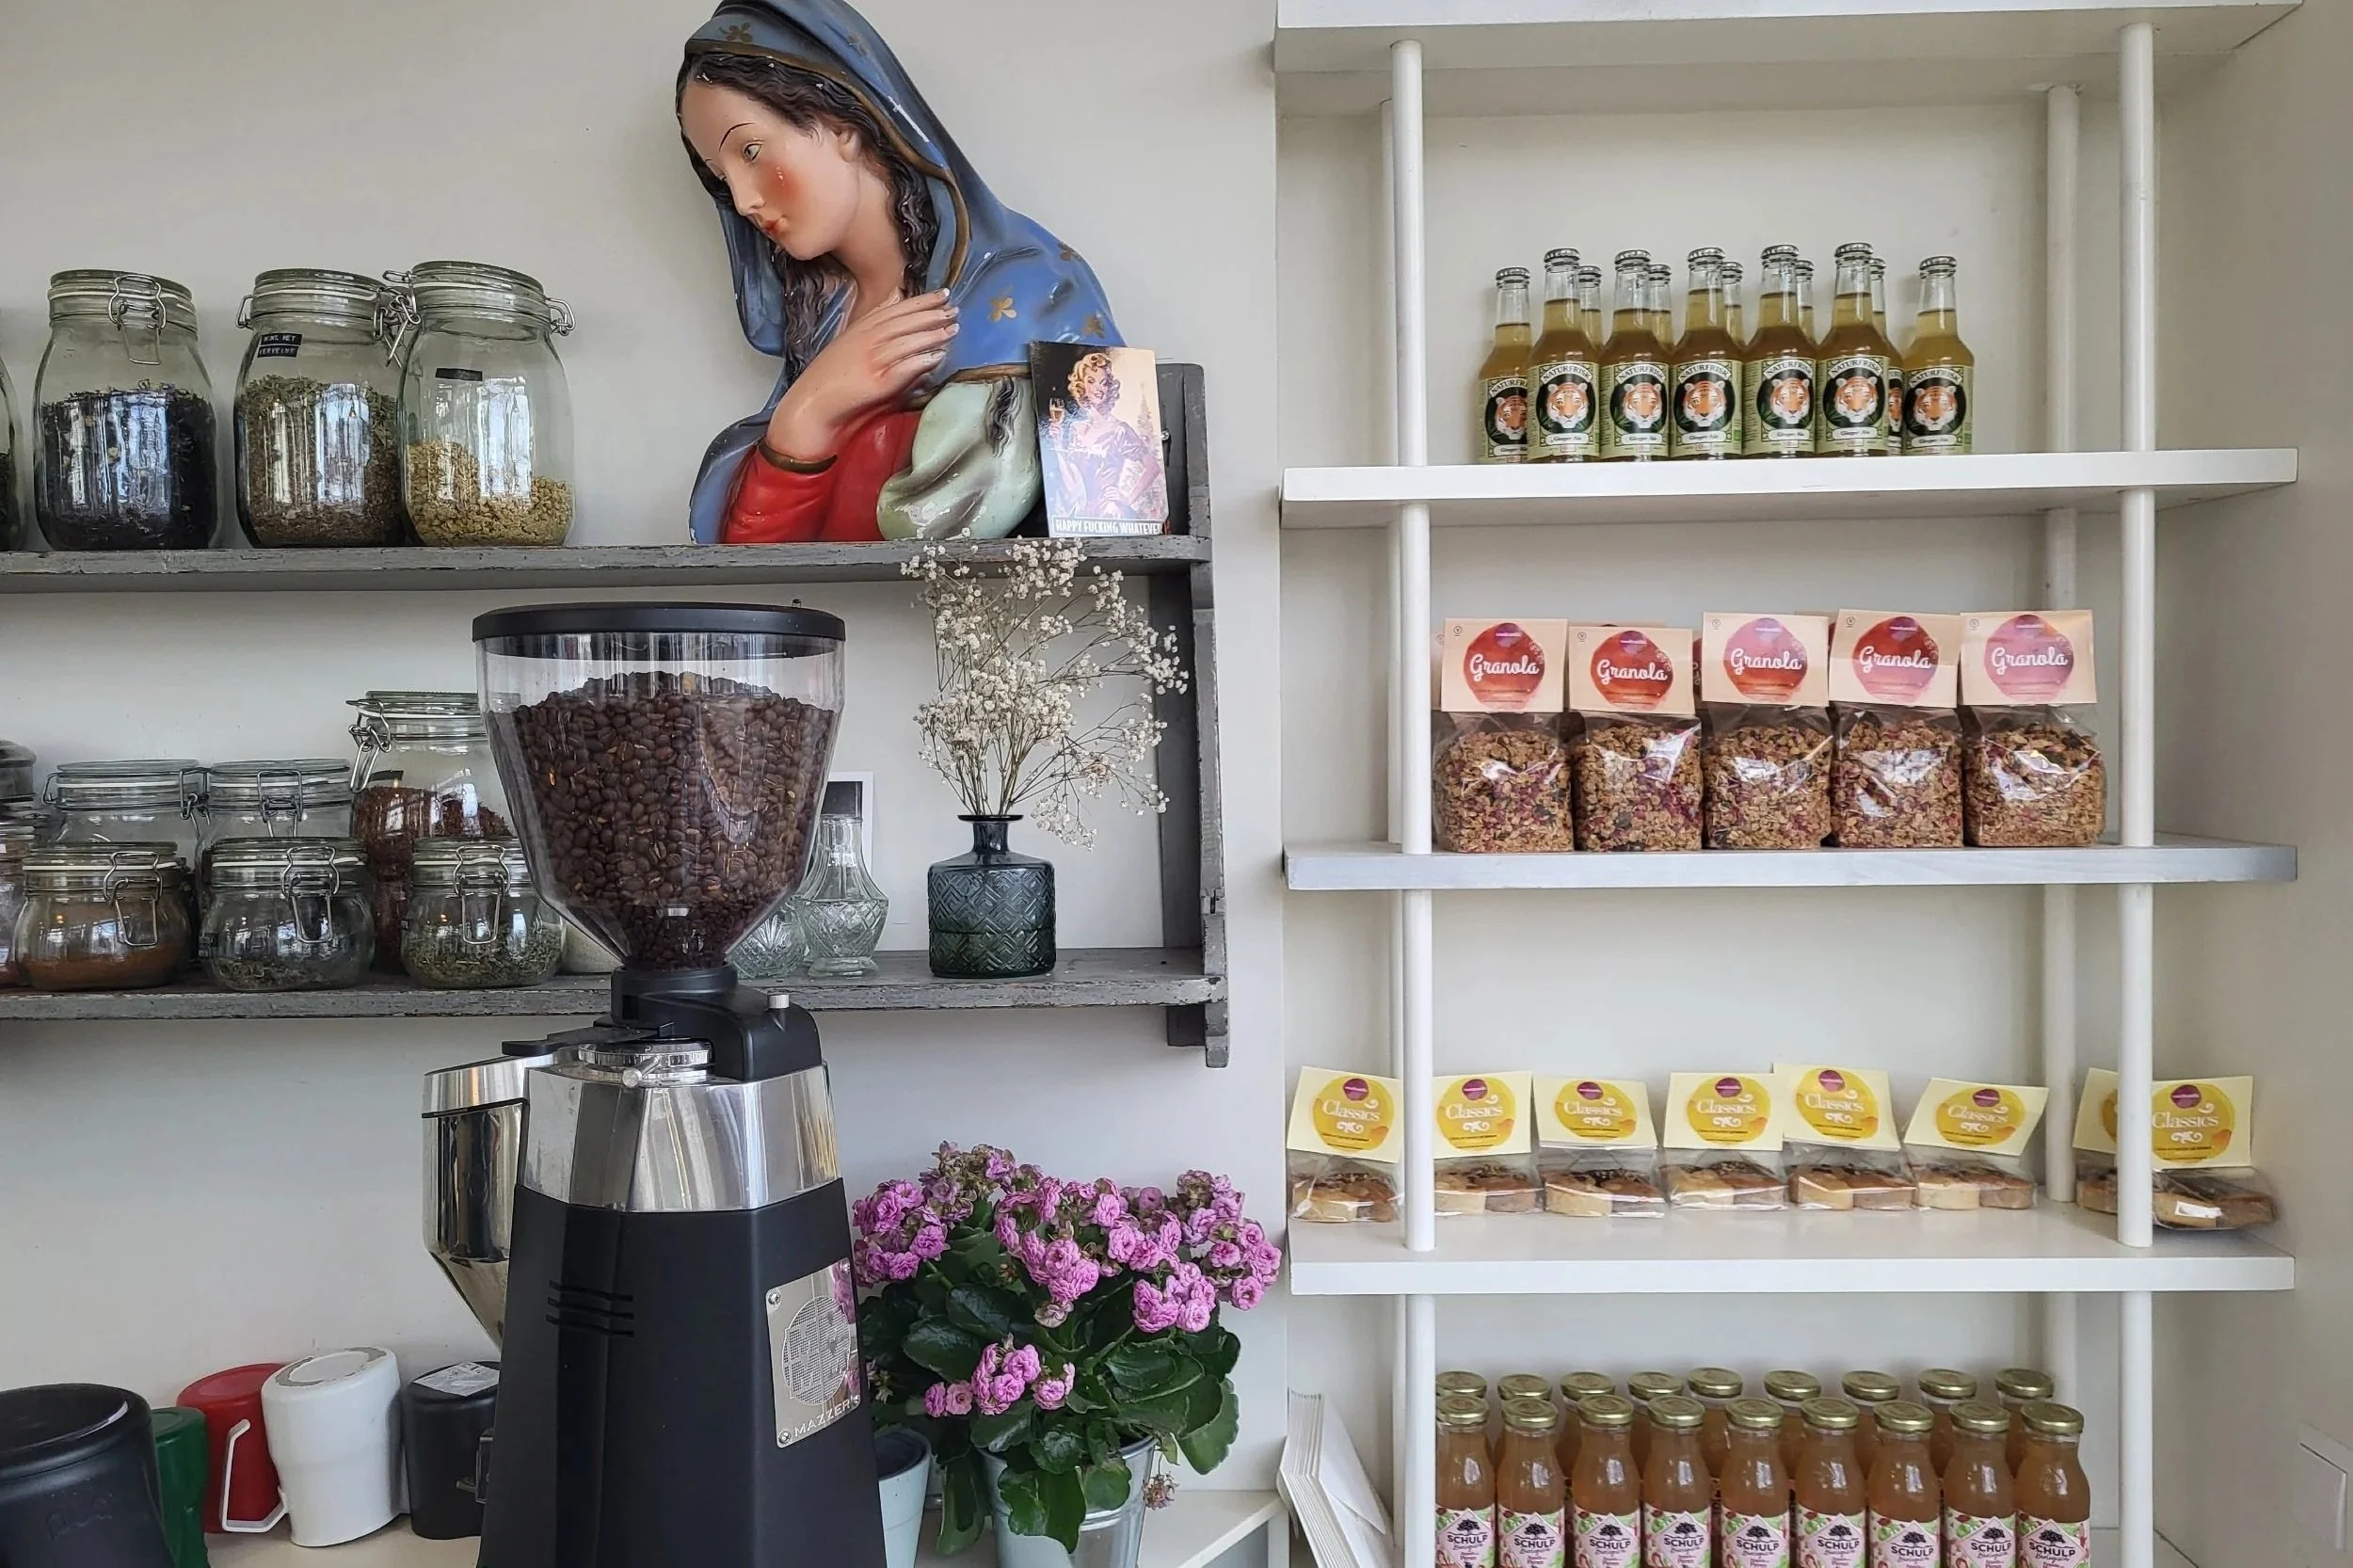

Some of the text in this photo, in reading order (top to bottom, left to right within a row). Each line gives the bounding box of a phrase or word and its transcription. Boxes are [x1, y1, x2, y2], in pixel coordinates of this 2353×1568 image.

[1543, 365, 1591, 380] NATURFRISK
[1831, 360, 1881, 375] NATURFRISK
[1055, 519, 1163, 535] HAPPY FUCKING WHATEVER
[1470, 653, 1540, 682] Granola
[1730, 648, 1802, 676] Granola
[1859, 646, 1932, 674] Granola
[1991, 647, 2068, 676] Granola
[1597, 659, 1669, 686] Granola
[1321, 1099, 1381, 1122] Classics
[1563, 1101, 1623, 1117] Classics
[1697, 1099, 1756, 1115] Classics
[1804, 1093, 1865, 1112] Classics
[1446, 1103, 1503, 1120] Classics
[1947, 1105, 2009, 1124] Classics
[2152, 1112, 2218, 1129] Classics
[794, 1399, 850, 1437] MAZZER
[1447, 1534, 1488, 1544] SCHULP
[1513, 1538, 1555, 1548] SCHULP
[1589, 1539, 1631, 1549] SCHULP
[1737, 1540, 1780, 1551] SCHULP
[1817, 1540, 1859, 1550] SCHULP
[1891, 1545, 1934, 1557] SCHULP
[1971, 1543, 2011, 1552] SCHULP
[2028, 1542, 2075, 1558] SCHULP
